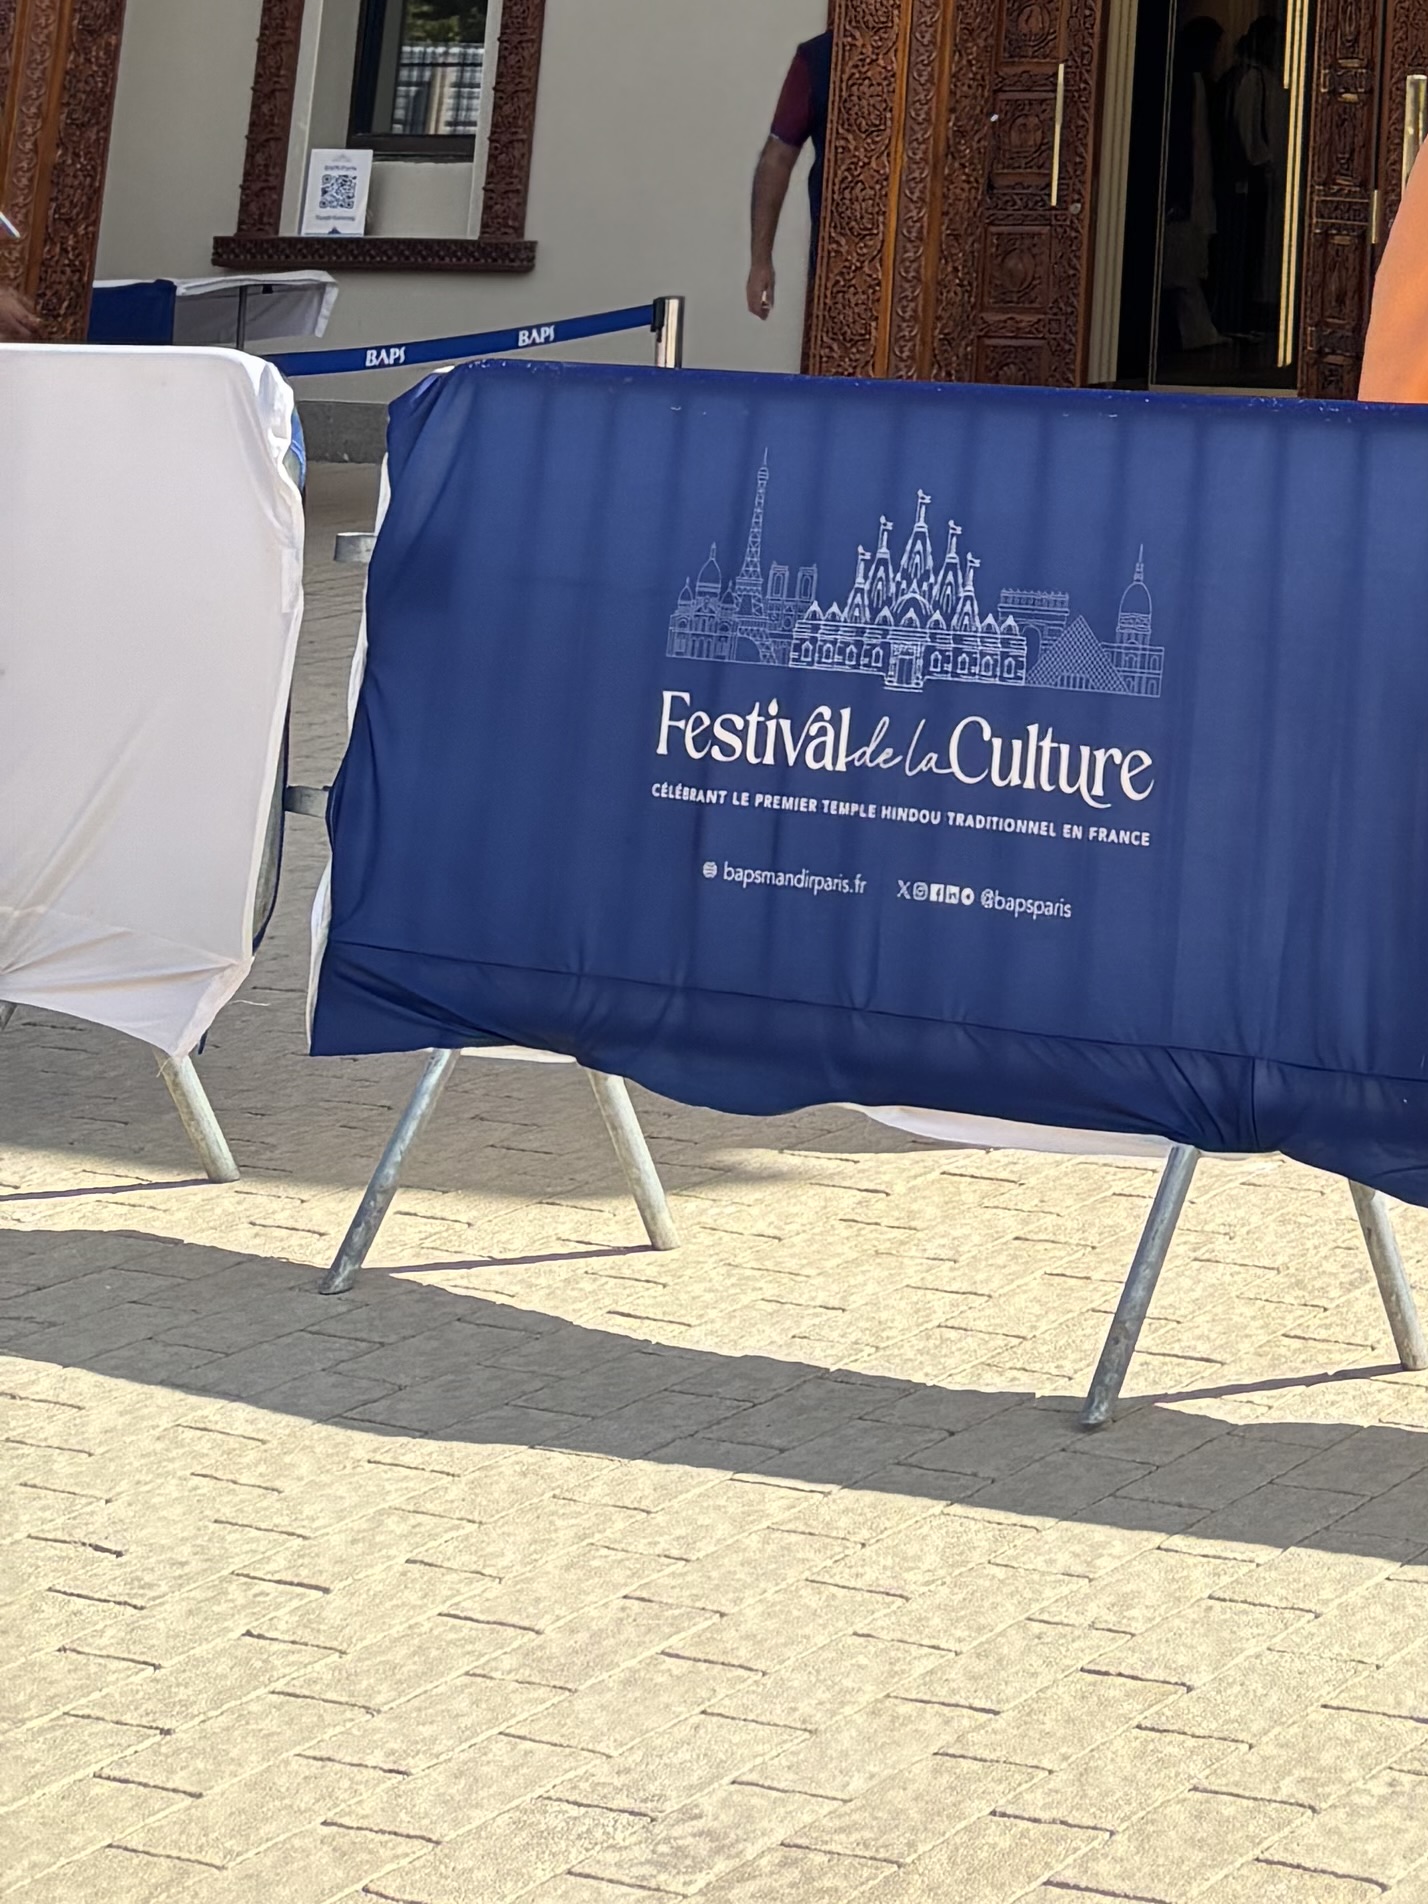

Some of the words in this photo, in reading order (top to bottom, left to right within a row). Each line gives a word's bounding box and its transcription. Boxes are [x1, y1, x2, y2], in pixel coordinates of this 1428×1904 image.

[365, 346, 406, 367] BAPS
[518, 325, 555, 347] BAPS
[656, 690, 851, 772] Festival
[848, 716, 903, 769] de
[905, 718, 953, 777] la
[949, 715, 1154, 808] Culture
[651, 782, 728, 804] CÉLÉBRANT
[732, 791, 750, 807] LE
[755, 793, 817, 813] PREMIER
[822, 799, 876, 819] TEMPLE
[881, 805, 941, 824] HINDOU
[947, 811, 1056, 837] TRADITIONNEL
[1063, 824, 1083, 840] EN
[1088, 826, 1151, 847] FRANCE
[723, 861, 867, 896] bapsmandirparis.fr
[980, 888, 1072, 920] @bapsparis
